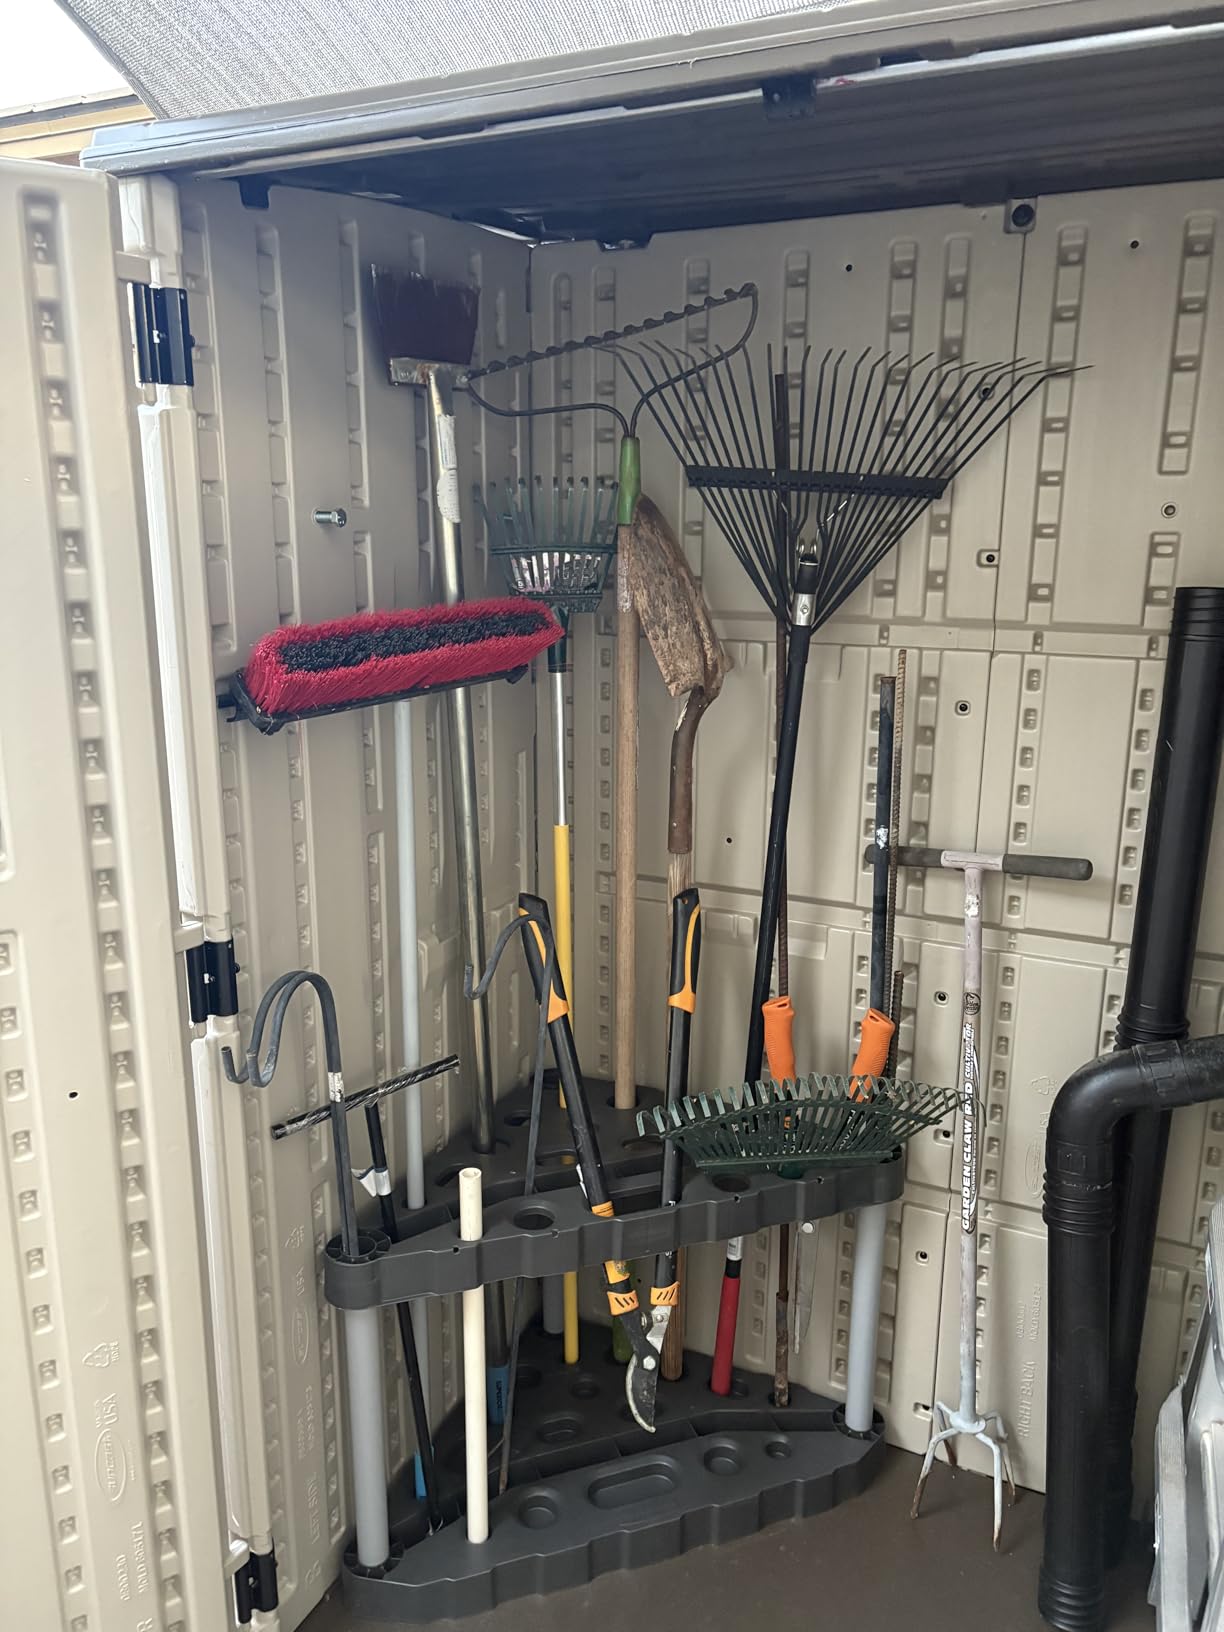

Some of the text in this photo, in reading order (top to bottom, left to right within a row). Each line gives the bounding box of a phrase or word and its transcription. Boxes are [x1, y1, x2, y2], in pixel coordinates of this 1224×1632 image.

[963, 1119, 972, 1163] CLAW
[962, 1165, 971, 1231] GARDEN
[101, 1392, 119, 1426] USA
